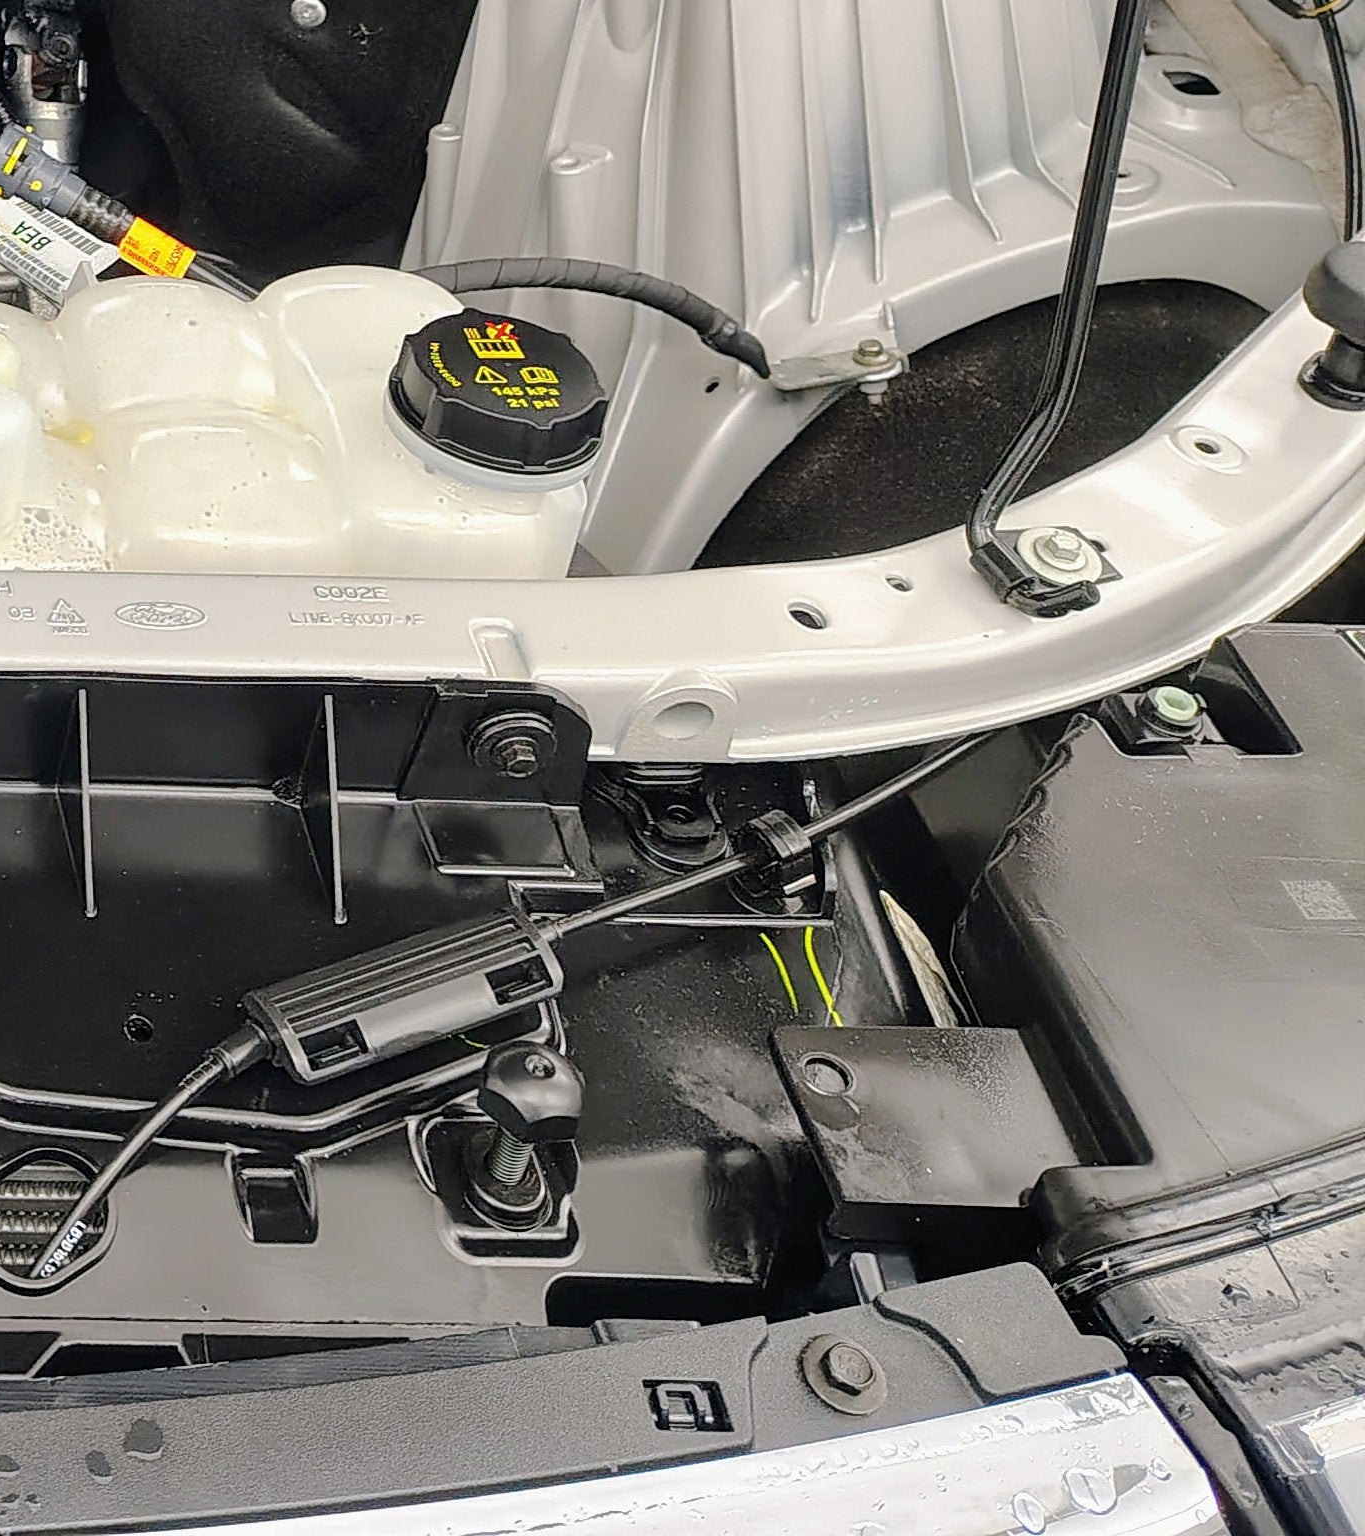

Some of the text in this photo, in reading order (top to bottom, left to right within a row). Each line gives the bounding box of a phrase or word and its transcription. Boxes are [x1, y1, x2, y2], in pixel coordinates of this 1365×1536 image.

[11, 220, 53, 251] BEA
[492, 386, 560, 397] 145 kPa
[507, 398, 560, 410] 21 psi
